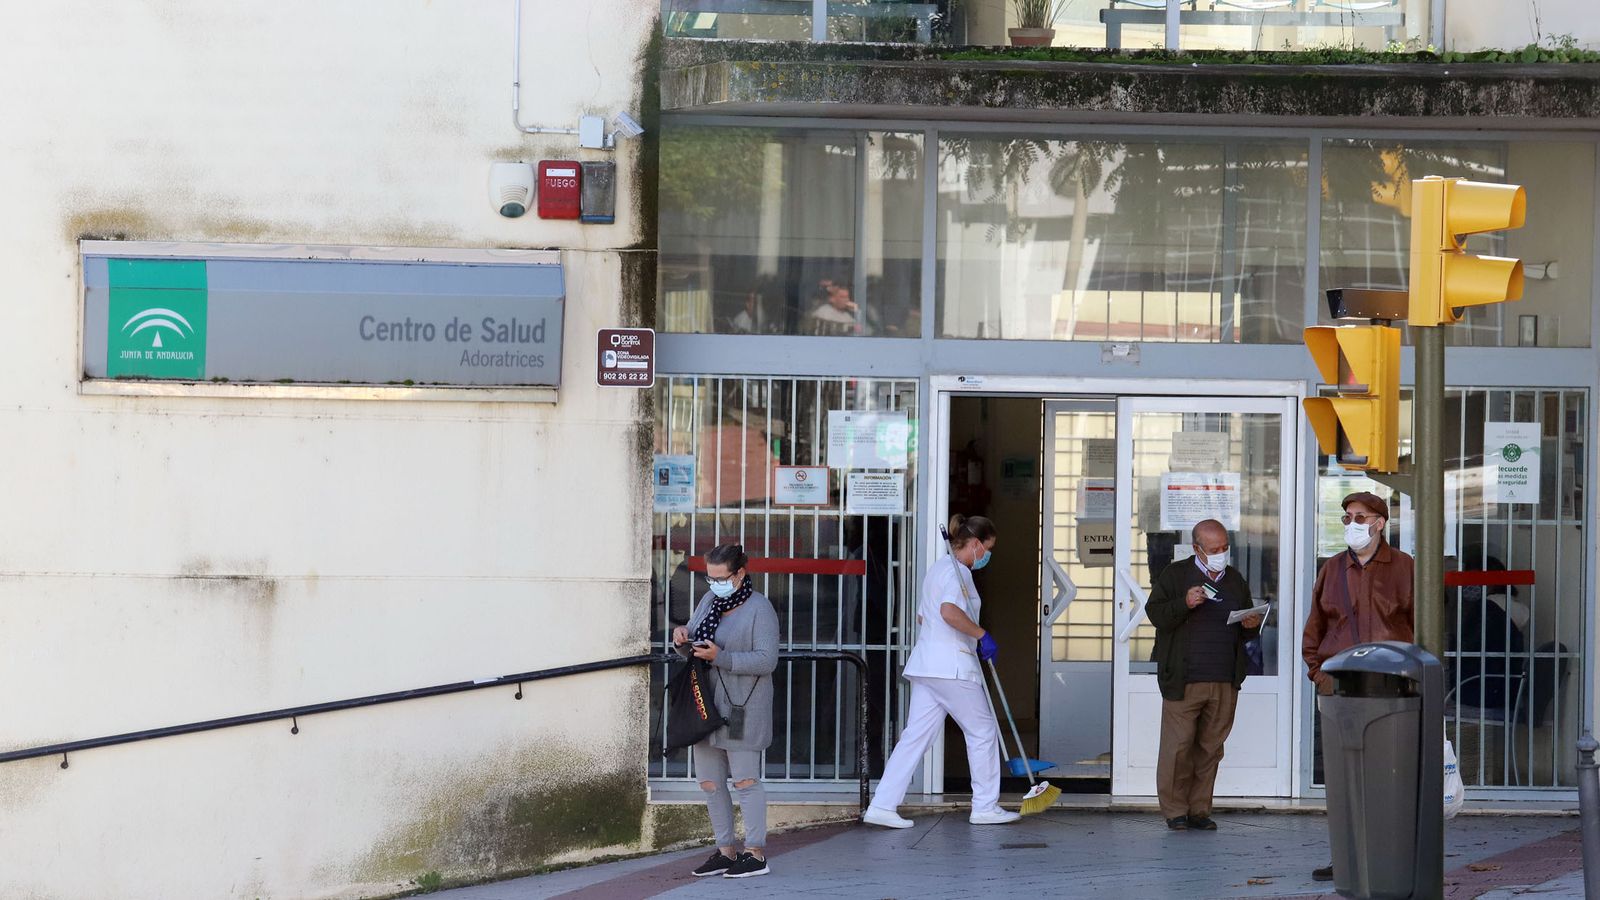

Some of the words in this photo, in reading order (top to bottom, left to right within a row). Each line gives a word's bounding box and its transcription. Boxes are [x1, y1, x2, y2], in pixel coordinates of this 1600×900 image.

[545, 178, 577, 188] FUEGO
[359, 315, 436, 342] Centro
[444, 316, 472, 342] de
[480, 316, 546, 344] Salud
[120, 350, 142, 360] JUNTA
[145, 351, 154, 360] DE
[459, 349, 545, 369] Adoratrices
[603, 372, 617, 380] 902
[618, 372, 627, 380] 26
